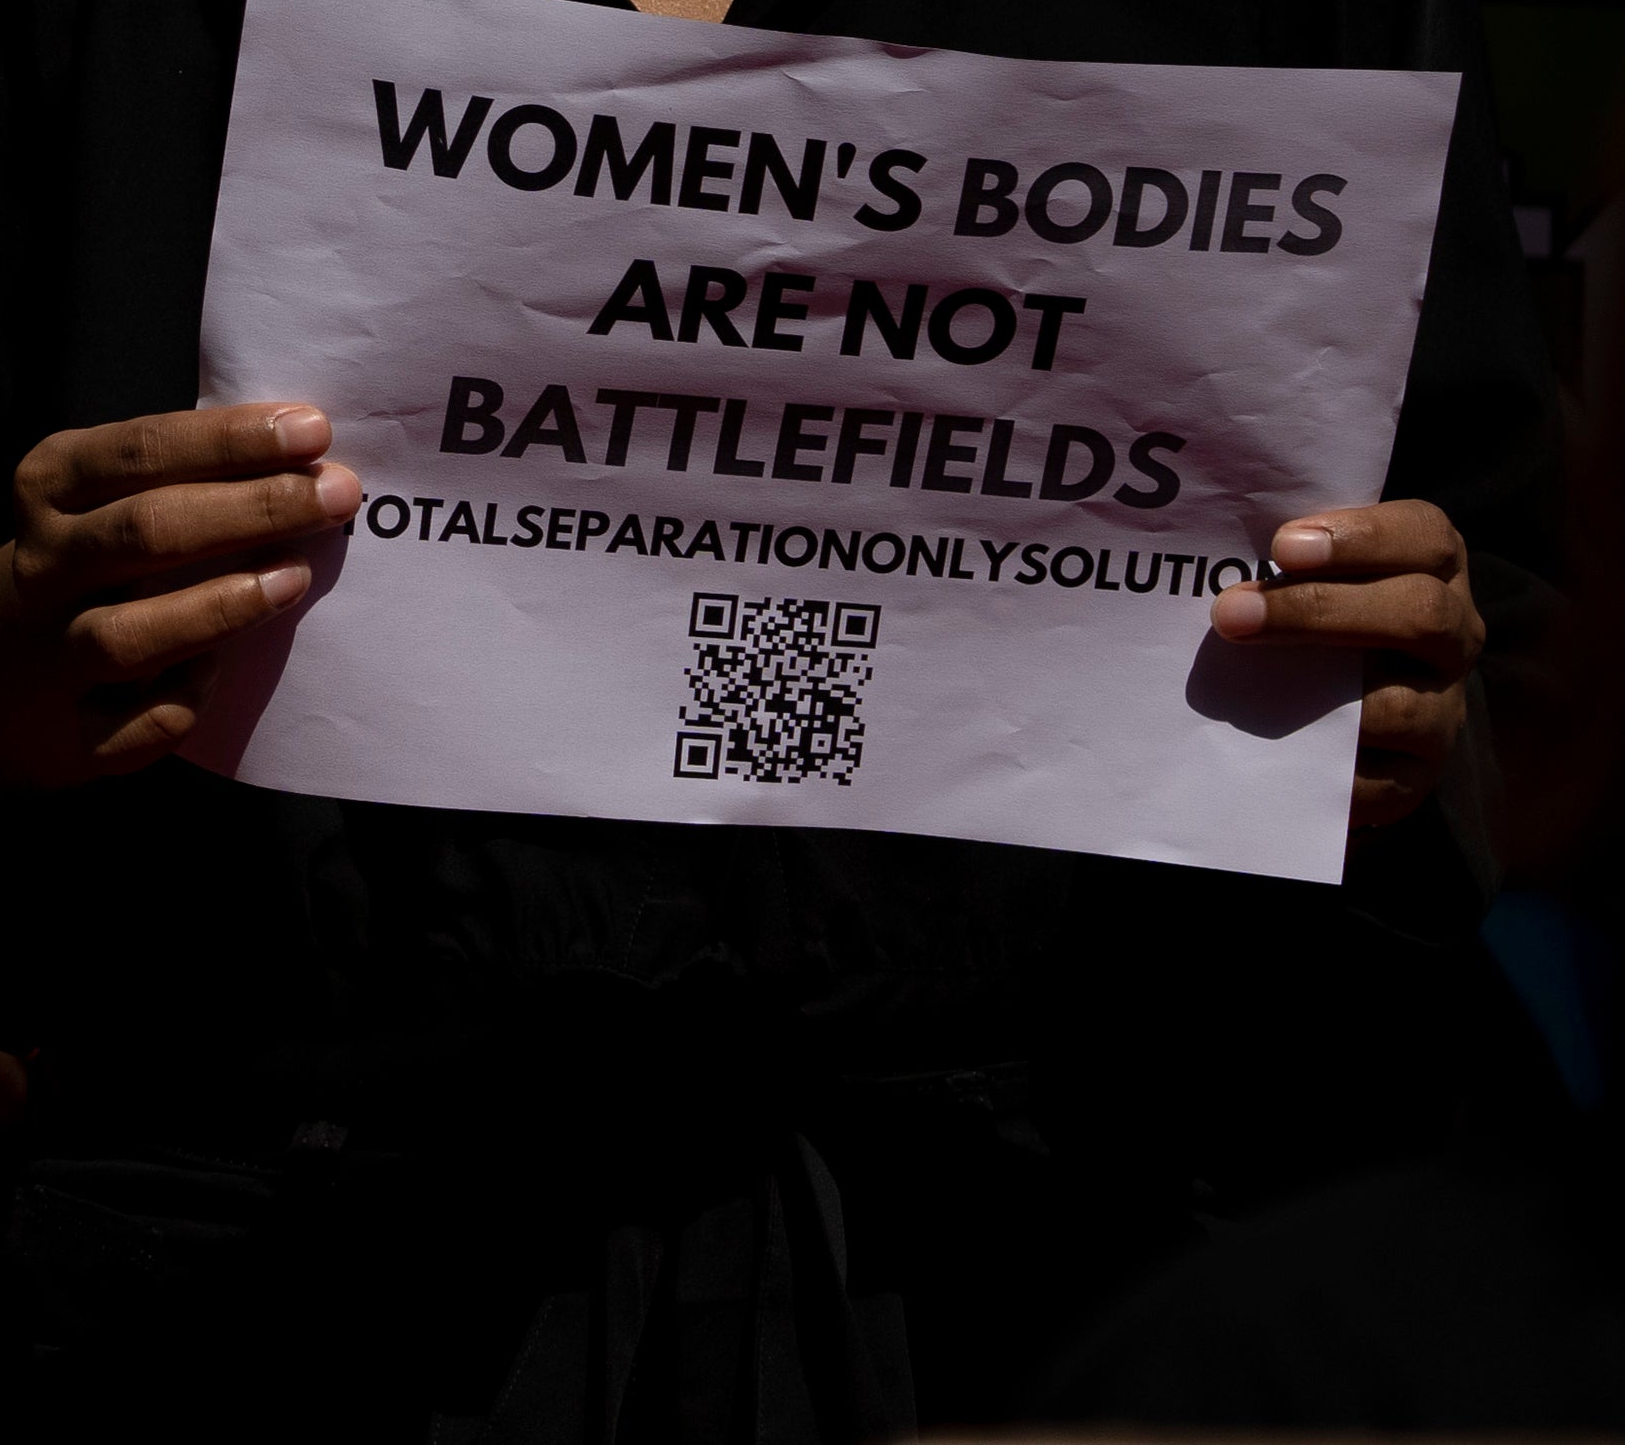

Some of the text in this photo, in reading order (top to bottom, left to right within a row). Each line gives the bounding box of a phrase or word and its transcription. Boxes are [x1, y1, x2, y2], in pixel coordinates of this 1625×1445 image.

[372, 79, 928, 232] WOMEN'S
[953, 158, 1347, 256] BODIES
[587, 259, 1086, 371] ARE NOT
[439, 376, 1186, 509] BATTLEFIELDS
